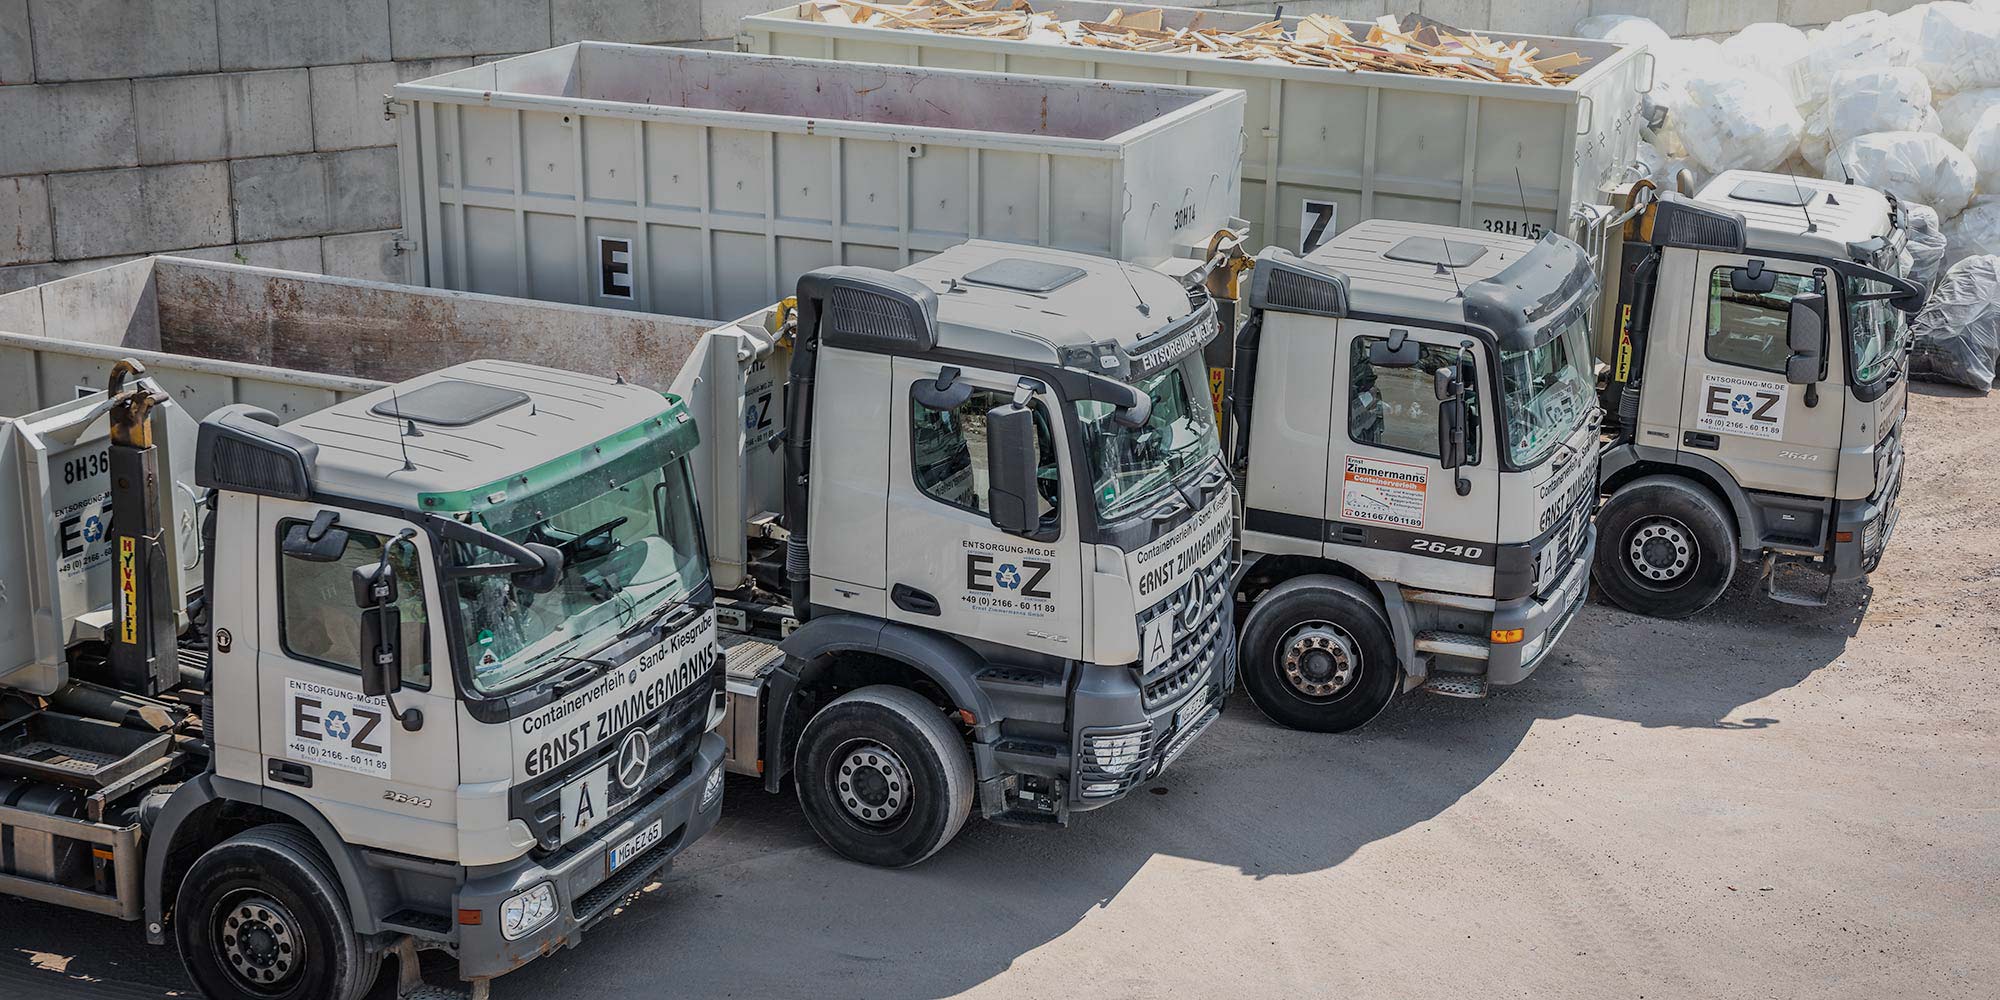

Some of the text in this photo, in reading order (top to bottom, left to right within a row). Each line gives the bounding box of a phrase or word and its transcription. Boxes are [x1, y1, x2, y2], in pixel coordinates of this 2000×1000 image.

[1174, 203, 1195, 230] 30H14
[1303, 202, 1334, 253] Z
[601, 239, 631, 298] E
[1705, 374, 1785, 391] ENTSORGUNG-MG.DE
[757, 393, 772, 430] Z
[1714, 419, 1725, 427] (0)
[1726, 421, 1744, 429] 2166
[1779, 450, 1818, 462] 2644
[1347, 463, 1425, 483] Zimmermanns
[60, 515, 84, 559] E
[962, 540, 1056, 557] ENTSORGUNG-MG.DE
[1139, 510, 1231, 596] ERNST ZIMMERMANNS
[1410, 539, 1482, 559] 2640
[967, 553, 1051, 599] E Z
[961, 595, 977, 604] +49
[979, 596, 990, 606] (0)
[992, 598, 1013, 608] 2166
[1020, 602, 1031, 610] 60
[1034, 603, 1042, 611] 11
[1044, 604, 1055, 613] 89
[1150, 622, 1165, 662] A
[522, 615, 713, 735] Containerverleih Sand- Kiesgrube
[289, 680, 387, 707] ENTSORGUNG-MG.DE
[524, 641, 713, 776] ERNST ZIMMERMANNS
[295, 696, 382, 754] E Z
[289, 742, 305, 752] +49
[307, 745, 319, 756] (0)
[321, 748, 343, 760] 2166
[350, 755, 361, 764] 60
[364, 758, 373, 766] 11
[376, 760, 387, 769] 89
[383, 790, 433, 808] 2644
[574, 781, 594, 828] A
